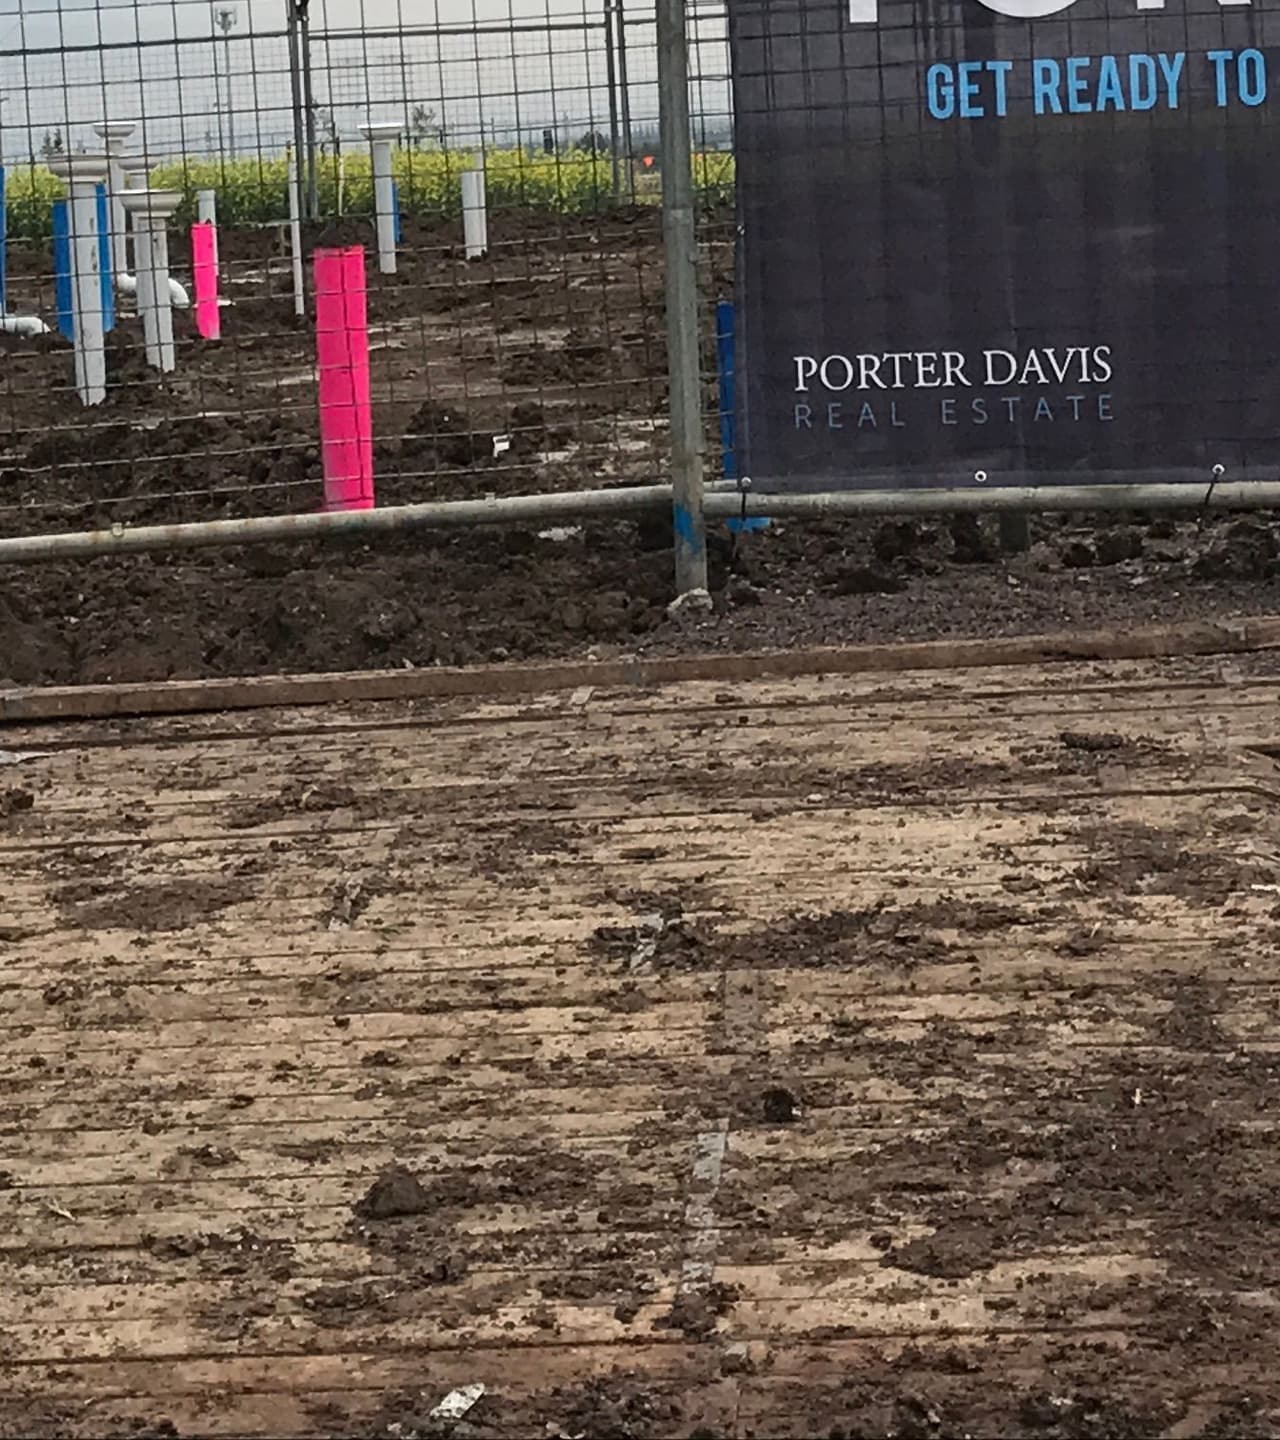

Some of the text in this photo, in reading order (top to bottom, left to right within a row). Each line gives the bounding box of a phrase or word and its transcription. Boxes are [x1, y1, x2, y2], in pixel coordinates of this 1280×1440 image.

[925, 58, 1012, 120] GET
[1034, 51, 1185, 115] READY
[1208, 46, 1267, 108] TO
[793, 345, 1113, 392] PORTER DAVIS
[794, 393, 1114, 429] REAL ESTATE
